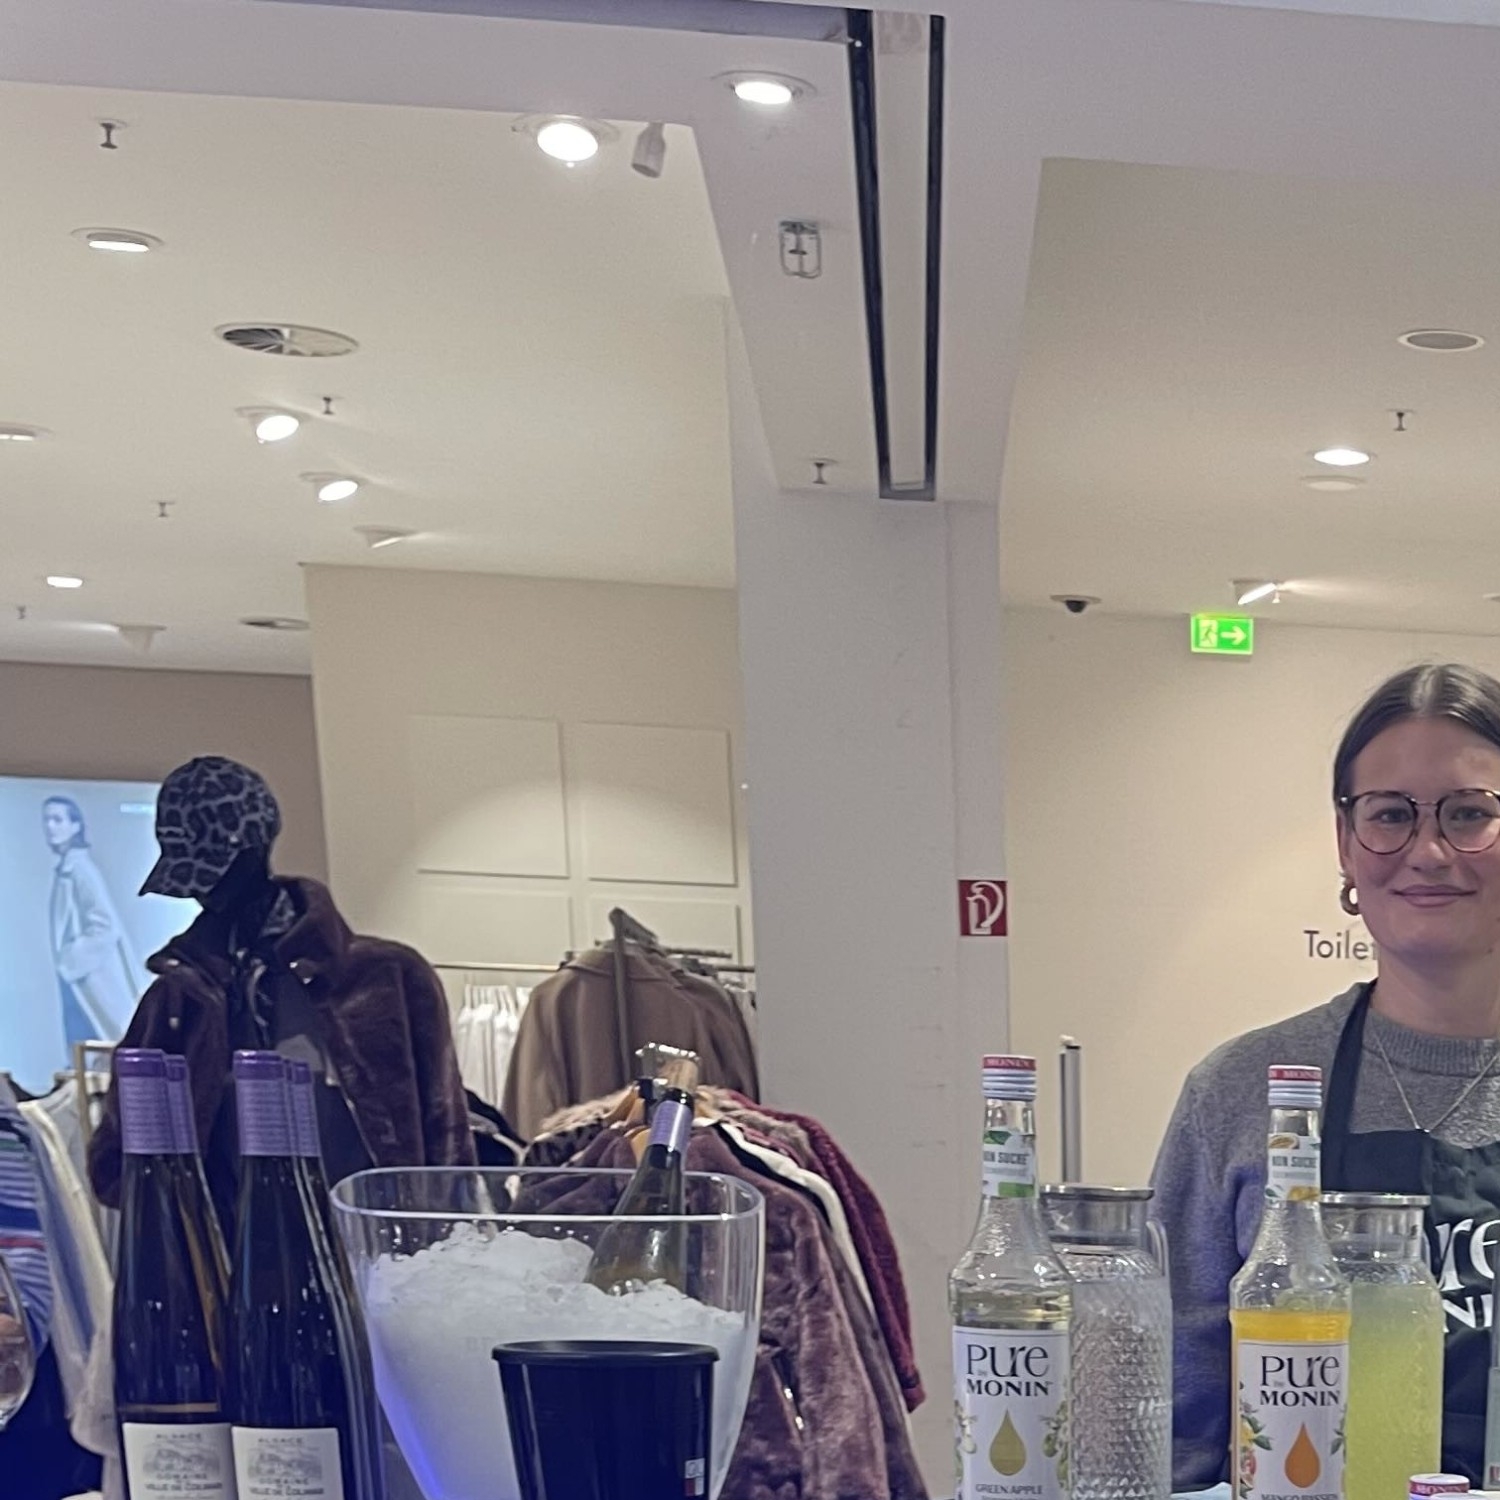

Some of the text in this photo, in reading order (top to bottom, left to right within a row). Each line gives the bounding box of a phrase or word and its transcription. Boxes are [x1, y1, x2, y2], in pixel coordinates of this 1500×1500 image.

[966, 1344, 1049, 1378] Pure
[1261, 1355, 1340, 1388] Pure
[967, 1378, 1050, 1397] MONIN
[1260, 1390, 1340, 1407] MONIN
